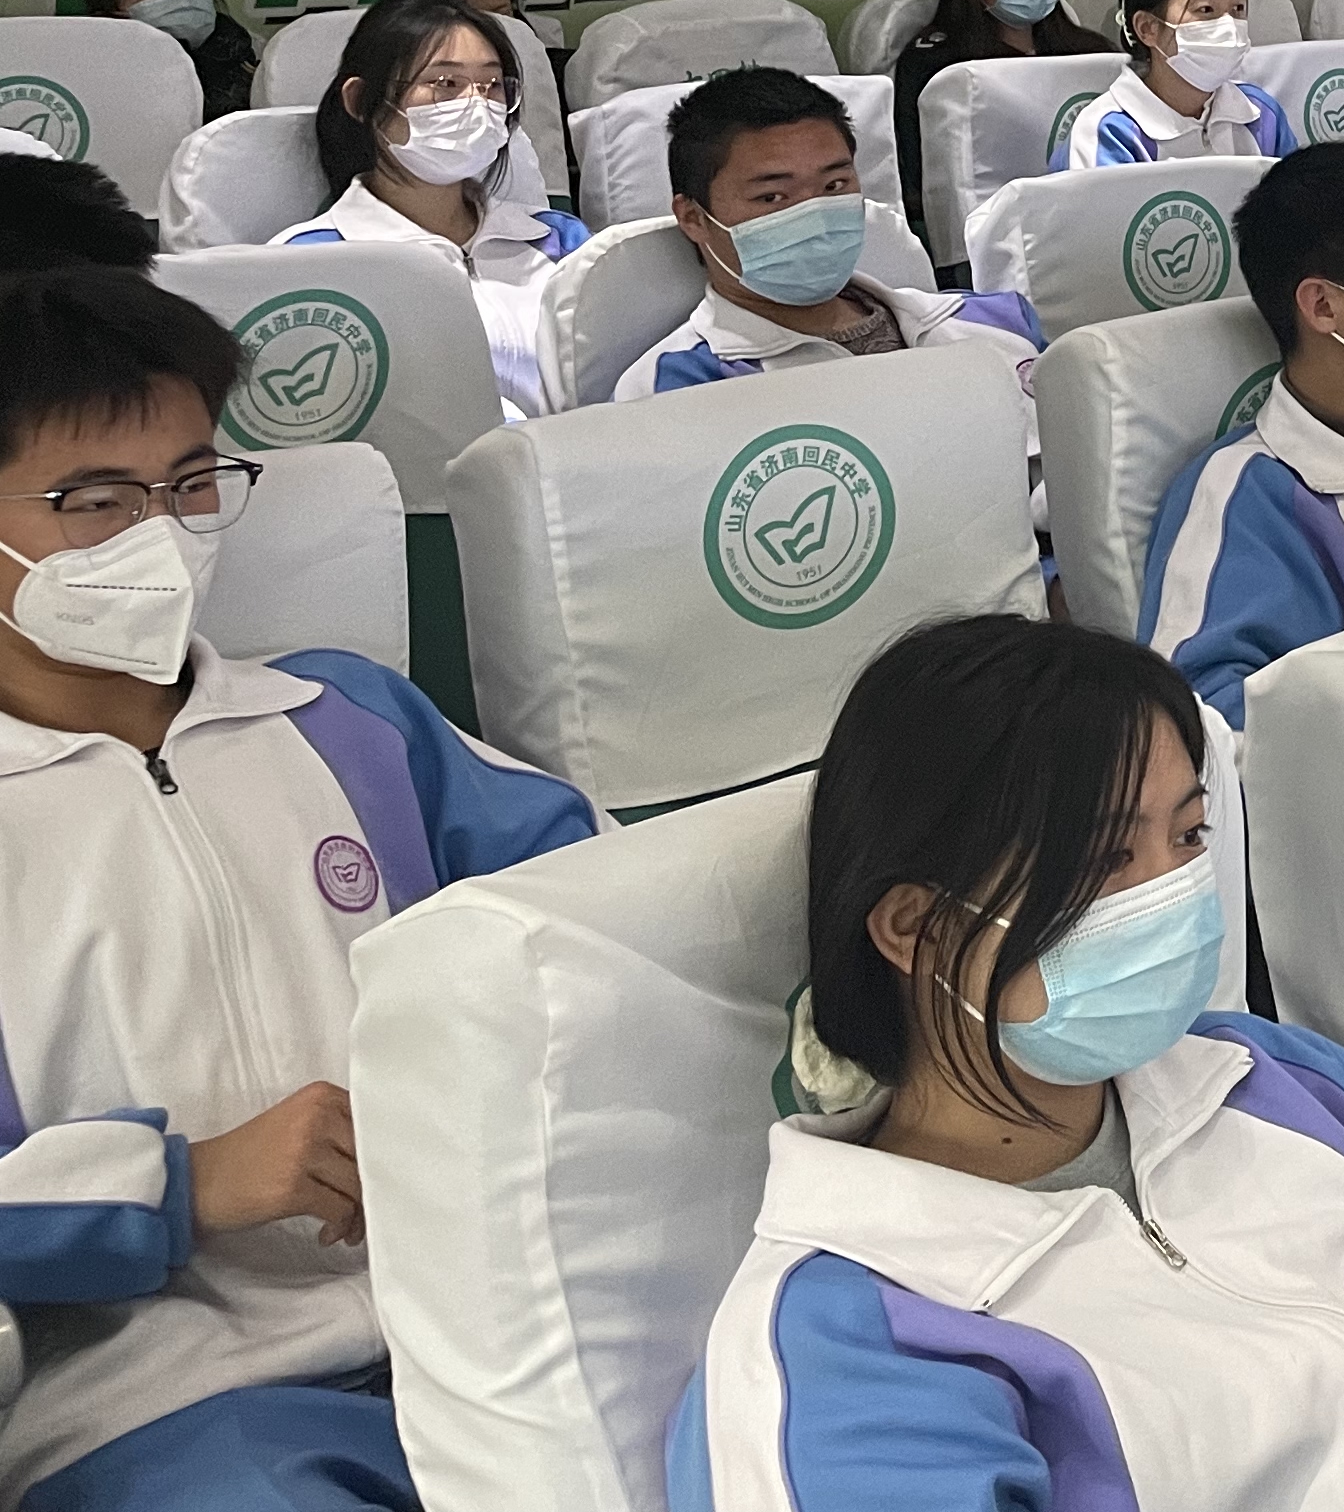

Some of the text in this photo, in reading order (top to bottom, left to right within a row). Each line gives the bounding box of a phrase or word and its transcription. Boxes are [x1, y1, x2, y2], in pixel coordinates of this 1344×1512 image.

[243, 307, 373, 359] 东省济南回民中学
[725, 445, 872, 533] 山东省济南回民中学
[795, 563, 823, 582] 1951
